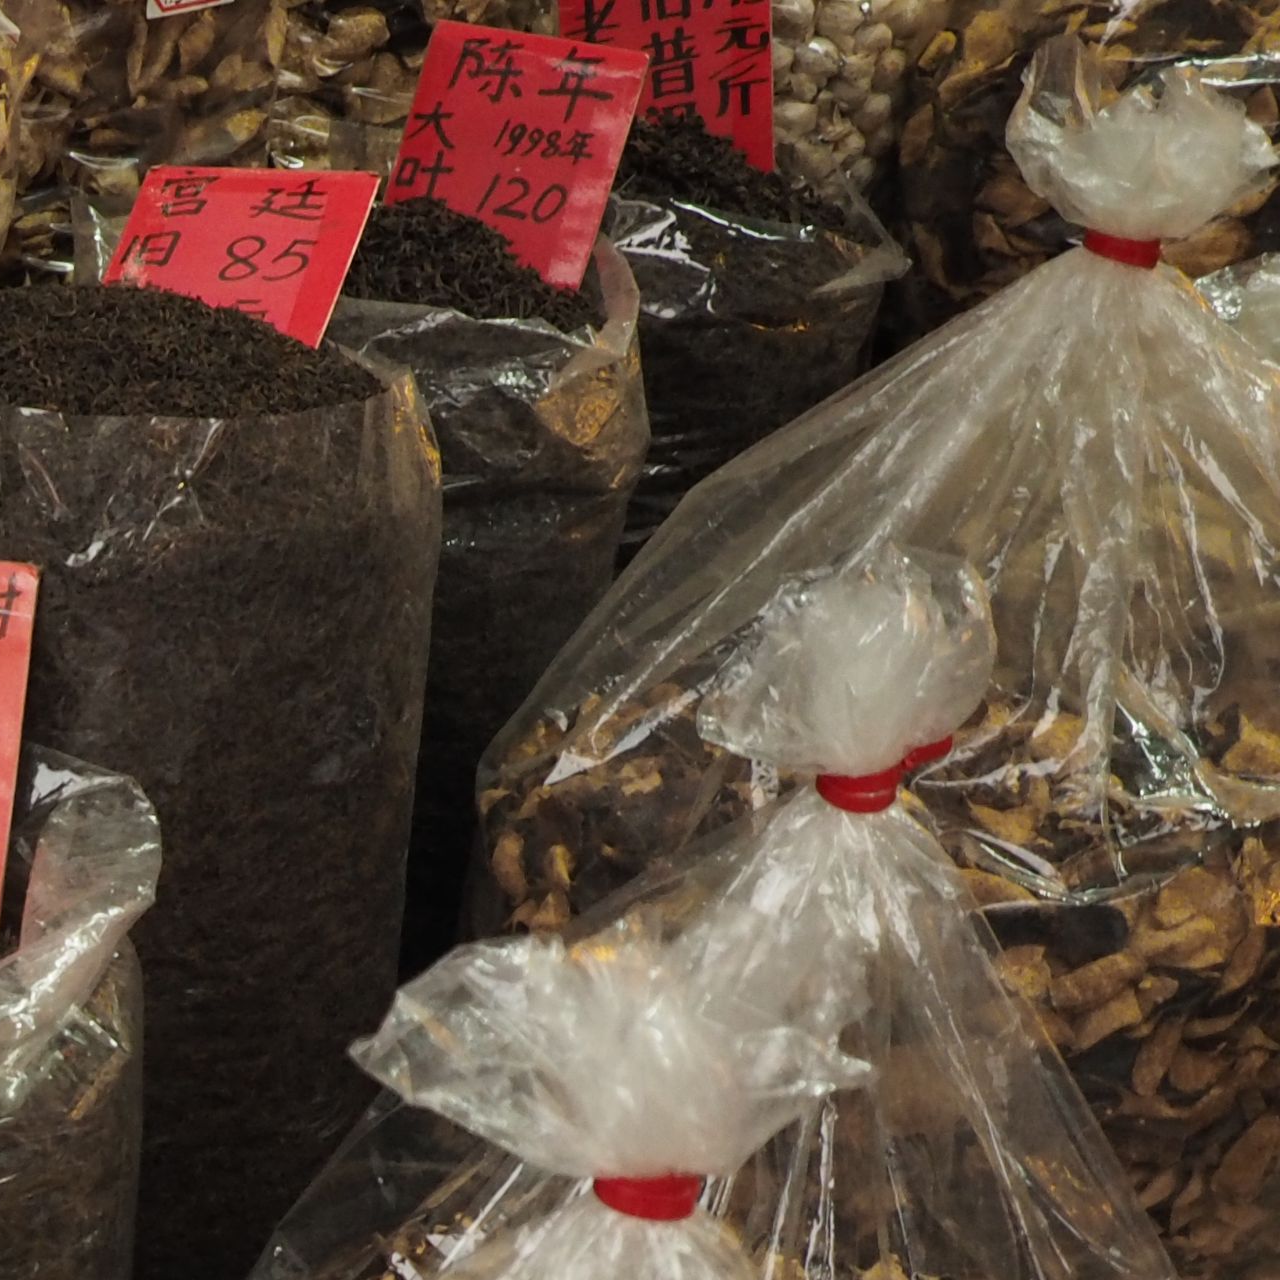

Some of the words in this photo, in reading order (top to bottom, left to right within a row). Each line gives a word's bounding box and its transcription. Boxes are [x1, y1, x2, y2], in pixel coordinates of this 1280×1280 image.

[448, 38, 614, 123] 陈年
[493, 118, 594, 166] 1998年
[159, 170, 328, 221] 宫廷
[476, 174, 568, 224] 120
[218, 235, 318, 281] 85
